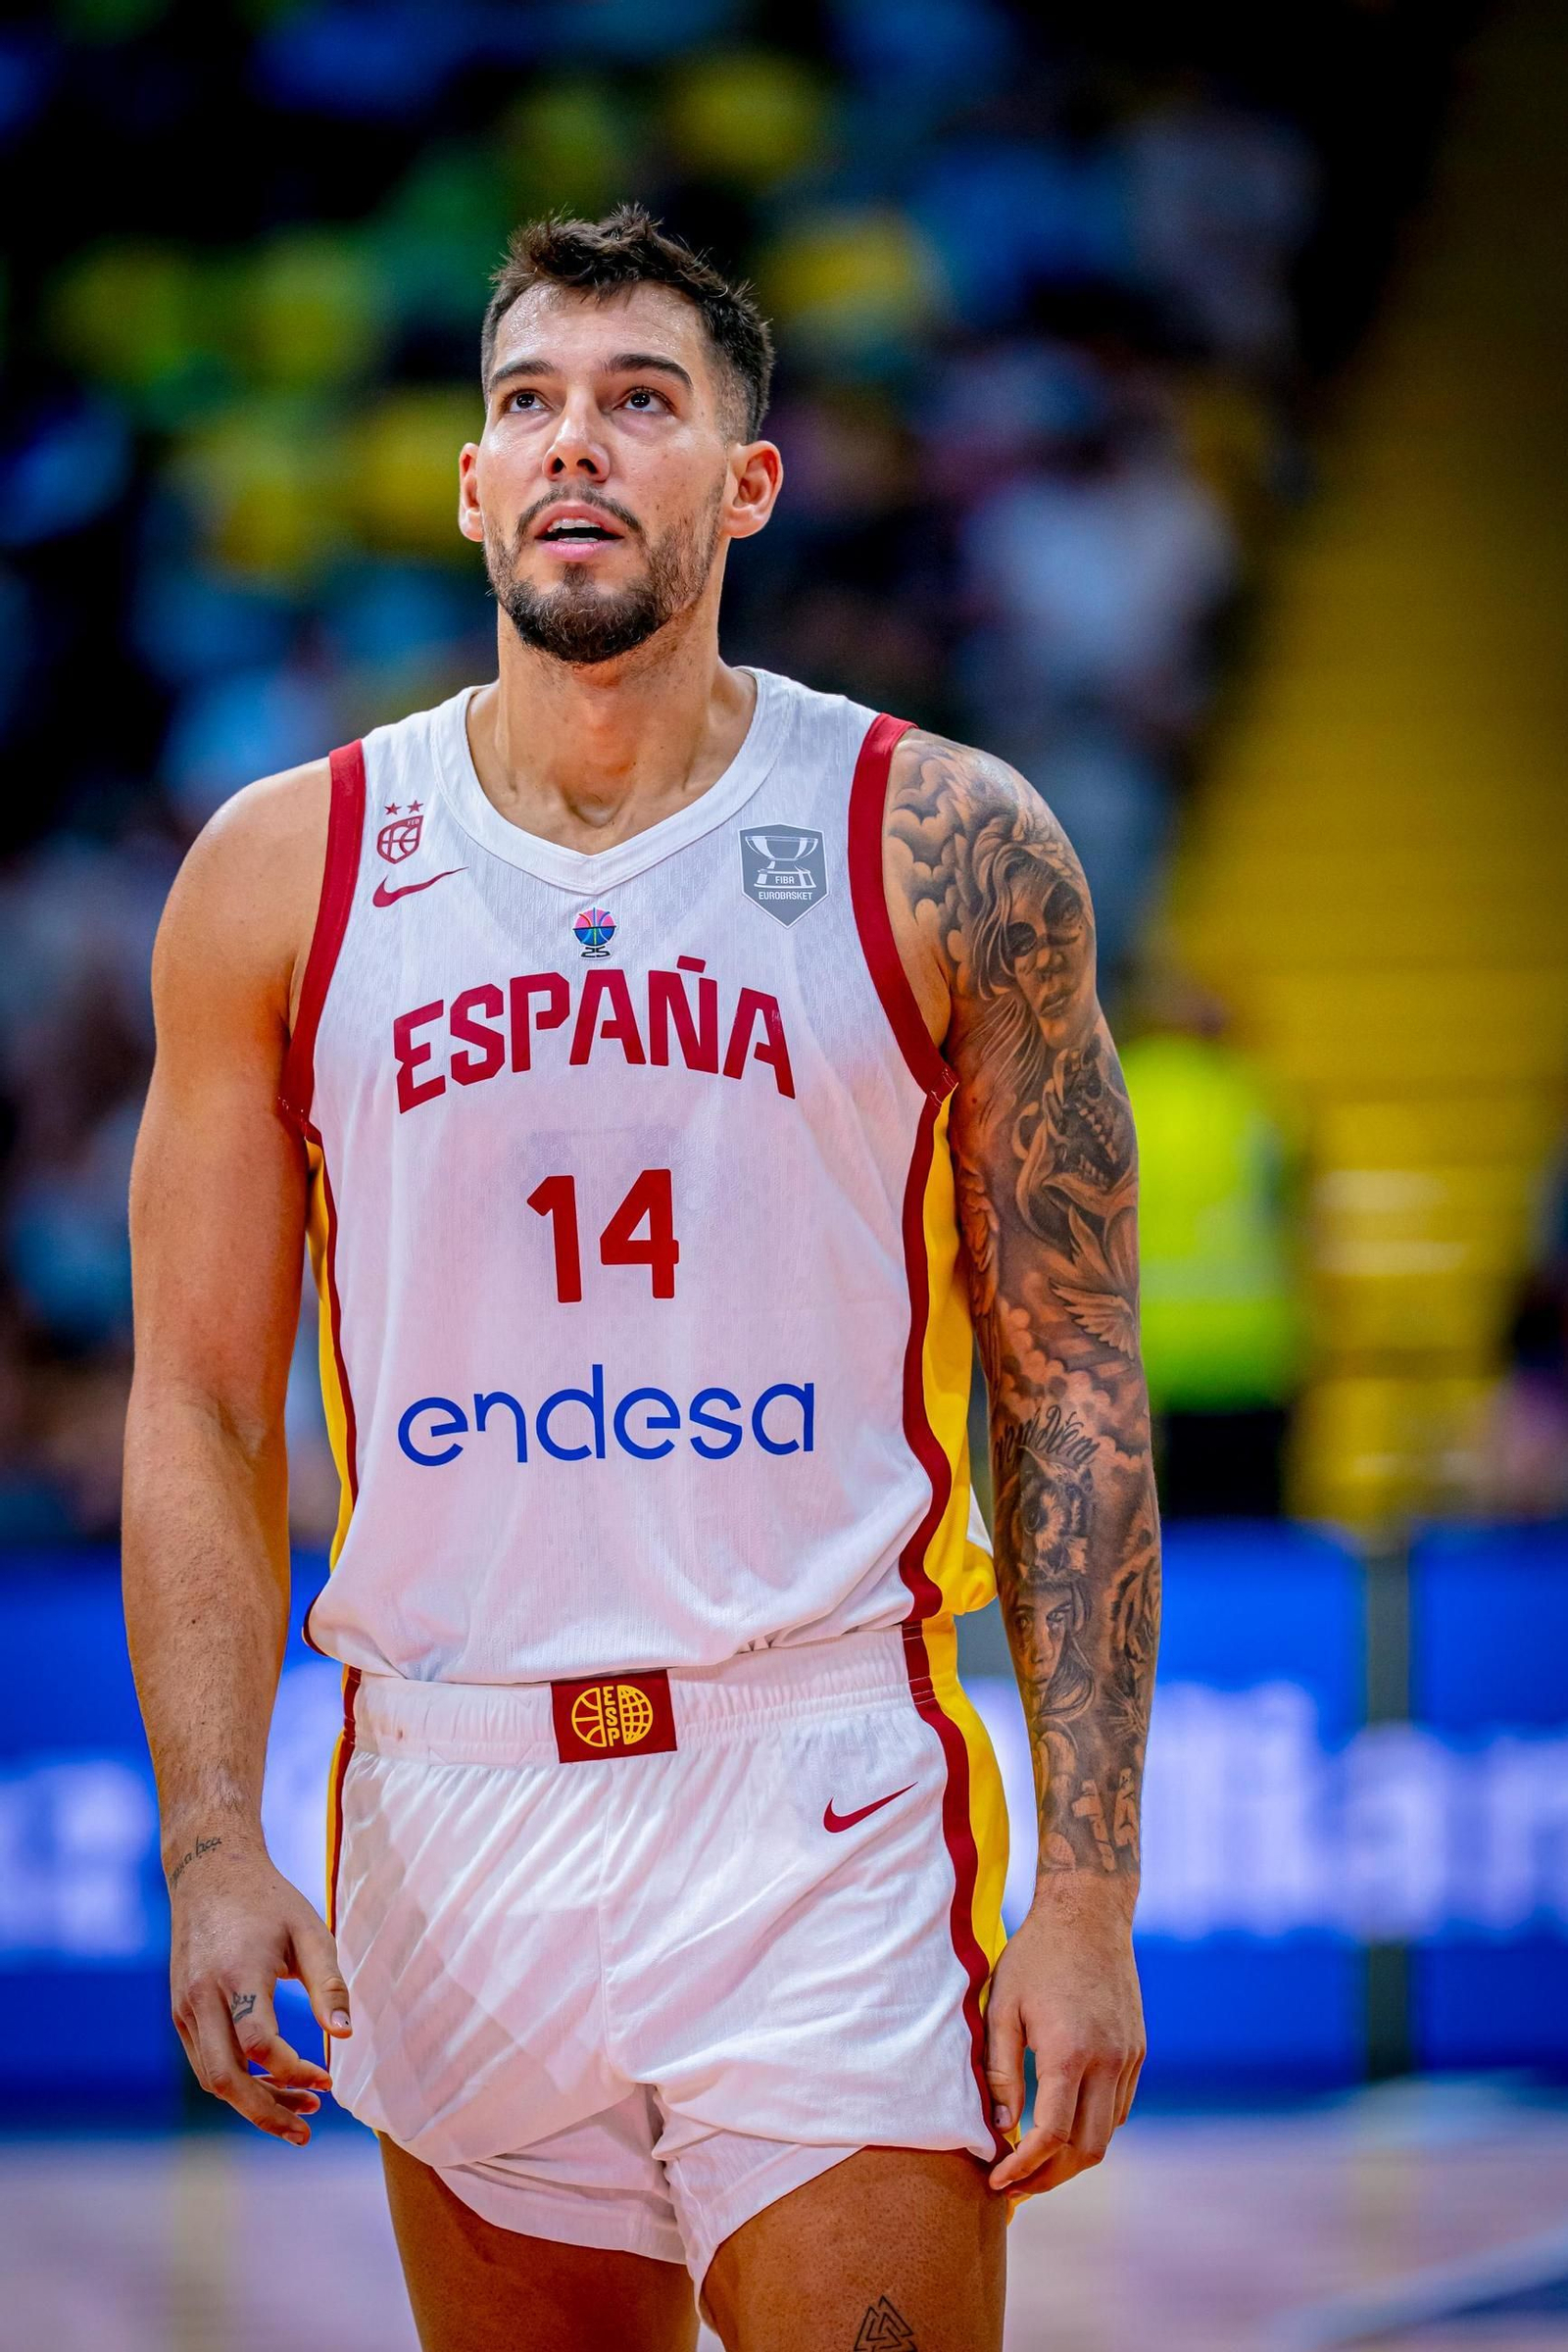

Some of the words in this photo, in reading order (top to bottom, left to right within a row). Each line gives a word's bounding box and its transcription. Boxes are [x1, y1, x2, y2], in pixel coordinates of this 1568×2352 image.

[758, 891, 813, 901] EUROBASKET
[774, 875, 795, 885] FIBA
[394, 955, 796, 1114] ESPAÑA
[526, 1168, 680, 1303] 14
[397, 1363, 814, 1467] endesa
[602, 1685, 620, 1747] ESP
